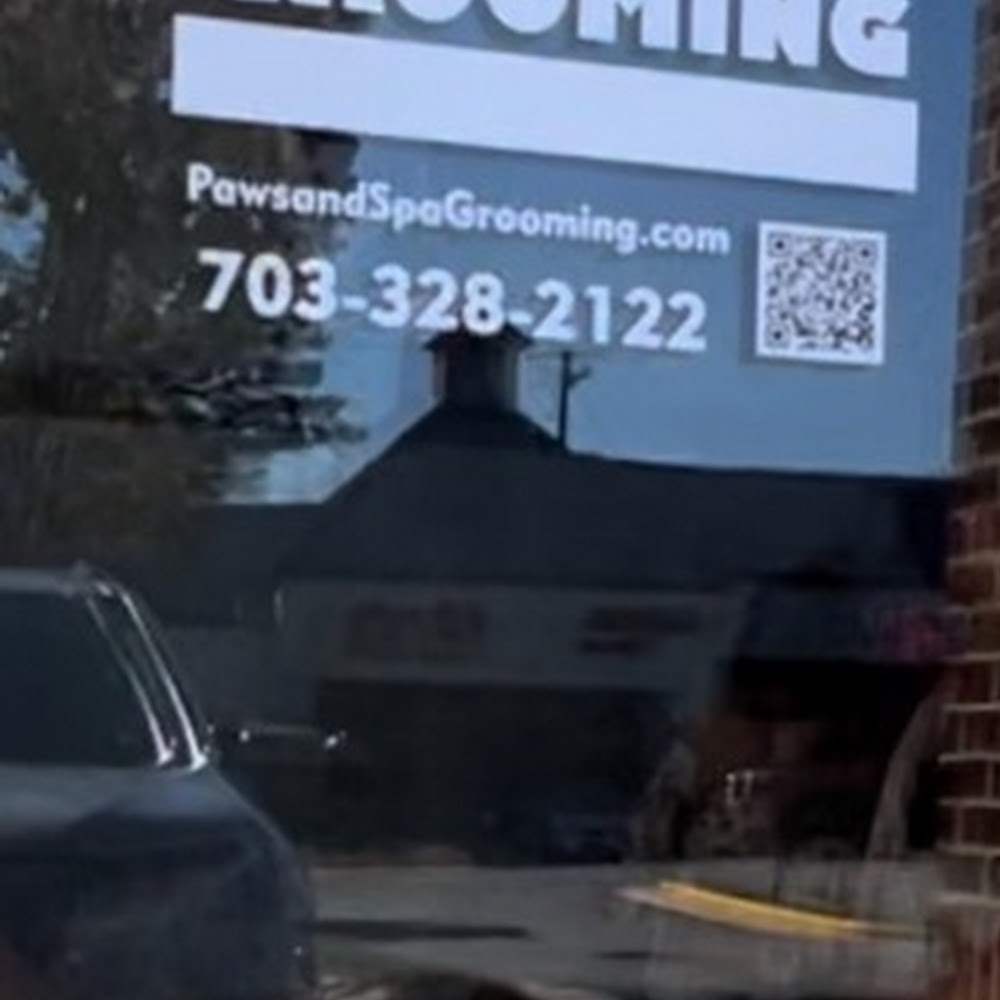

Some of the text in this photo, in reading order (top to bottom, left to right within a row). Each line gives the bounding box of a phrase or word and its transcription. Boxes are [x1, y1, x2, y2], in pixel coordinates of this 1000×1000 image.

[235, 0, 908, 78] MING
[187, 162, 731, 254] PawsandSpaGrooming.com
[197, 248, 707, 352] 703-328-2122
